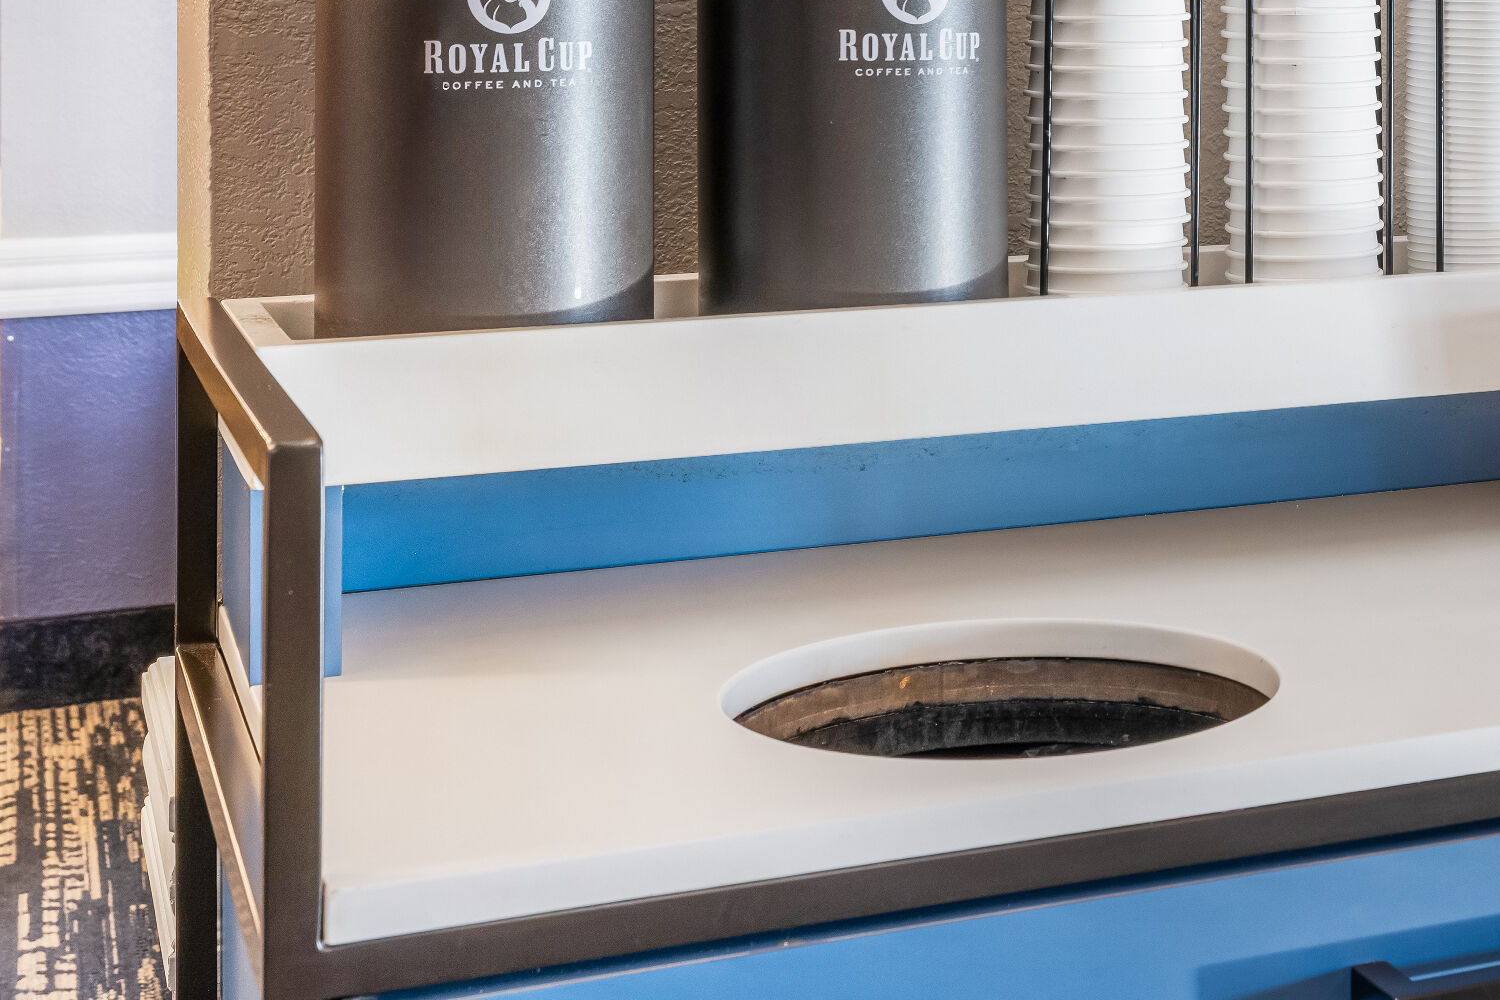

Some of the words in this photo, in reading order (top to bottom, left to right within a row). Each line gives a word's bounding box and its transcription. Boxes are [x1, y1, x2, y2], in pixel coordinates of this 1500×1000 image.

[423, 39, 530, 74] ROYAL
[538, 37, 593, 73] CUP
[838, 29, 933, 61] ROYAL
[939, 28, 980, 61] CUP
[854, 68, 911, 76] COFFEE
[917, 67, 943, 75] AND
[949, 66, 969, 75] TEA
[442, 80, 504, 91] COFFEE
[511, 79, 543, 89] AND
[550, 78, 577, 88] TEA
